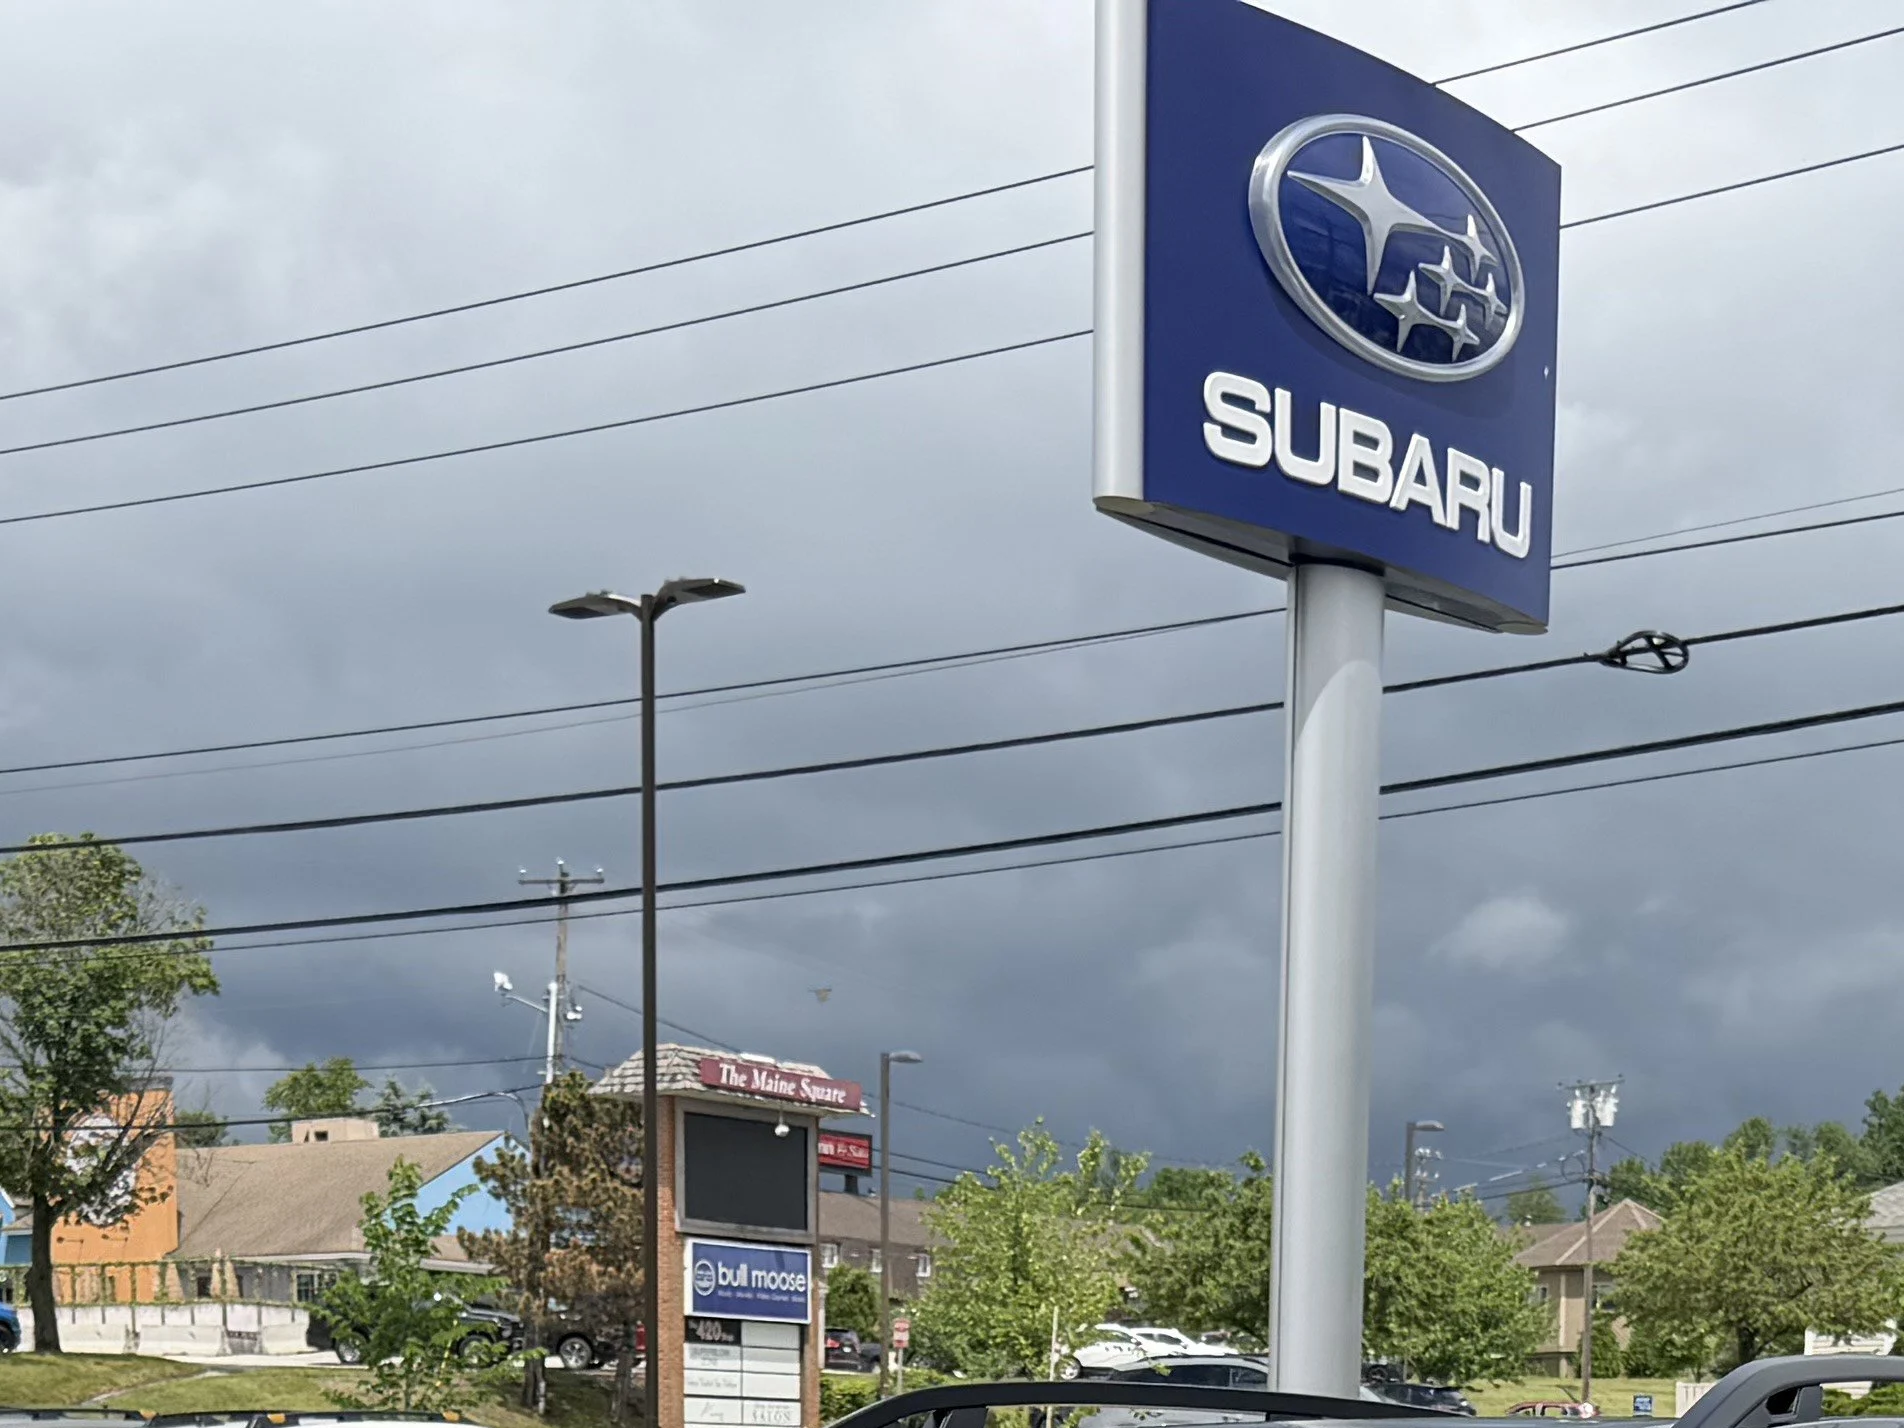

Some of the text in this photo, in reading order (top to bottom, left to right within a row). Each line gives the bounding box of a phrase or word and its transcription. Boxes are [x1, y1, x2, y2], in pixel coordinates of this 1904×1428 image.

[1202, 371, 1532, 559] SUBARU
[719, 1063, 847, 1103] The Maine Square
[717, 1261, 806, 1292] bull moose
